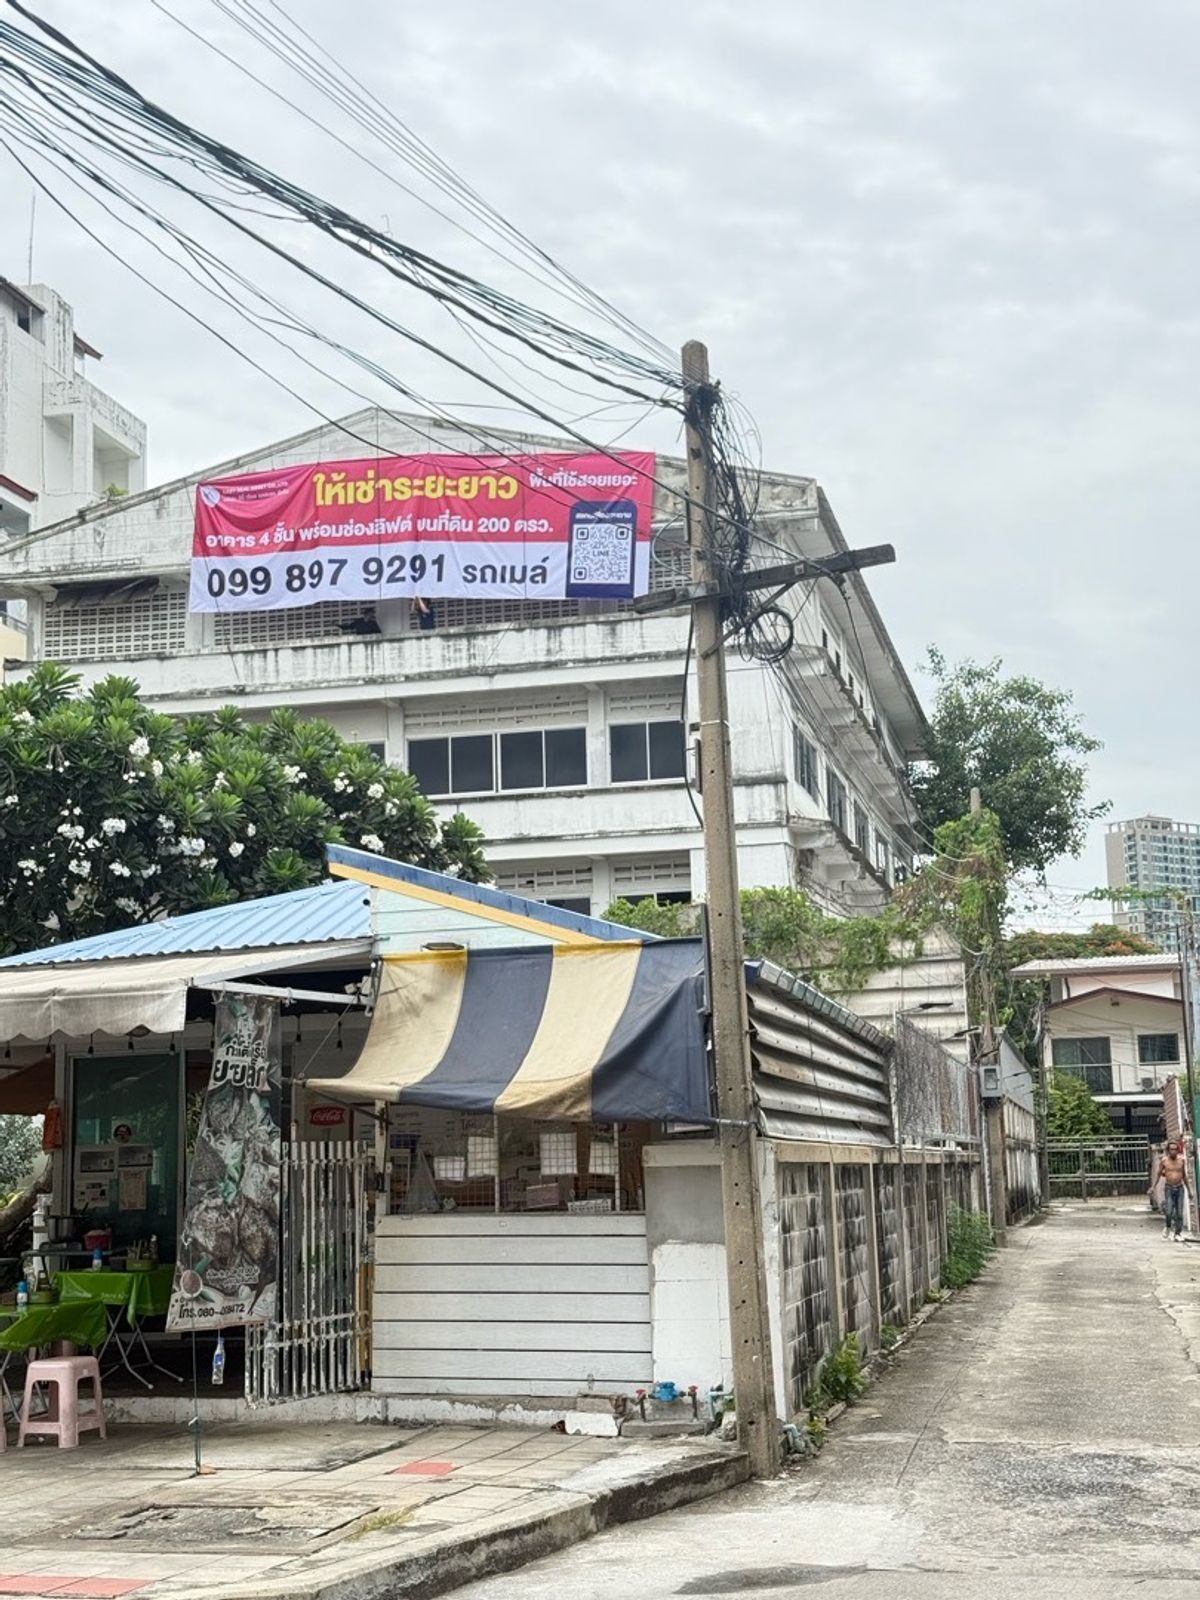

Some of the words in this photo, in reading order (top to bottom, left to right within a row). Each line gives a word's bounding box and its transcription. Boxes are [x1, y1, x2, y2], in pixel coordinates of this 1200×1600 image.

[313, 468, 518, 506] ให้เช่าระยะยาว
[529, 466, 638, 488] พื้นที่ใช้สอยเยอะ
[205, 534, 256, 548] อาคาร
[259, 532, 270, 546] 4
[273, 521, 295, 543] ชั้น
[300, 513, 412, 541] พร้อมช่องลิฟต์
[477, 517, 511, 533] 200
[514, 518, 553, 533] ตรว.
[207, 565, 272, 598] 099
[286, 558, 348, 593] 897
[362, 553, 446, 585] 9291
[462, 555, 548, 584] รถเมล์
